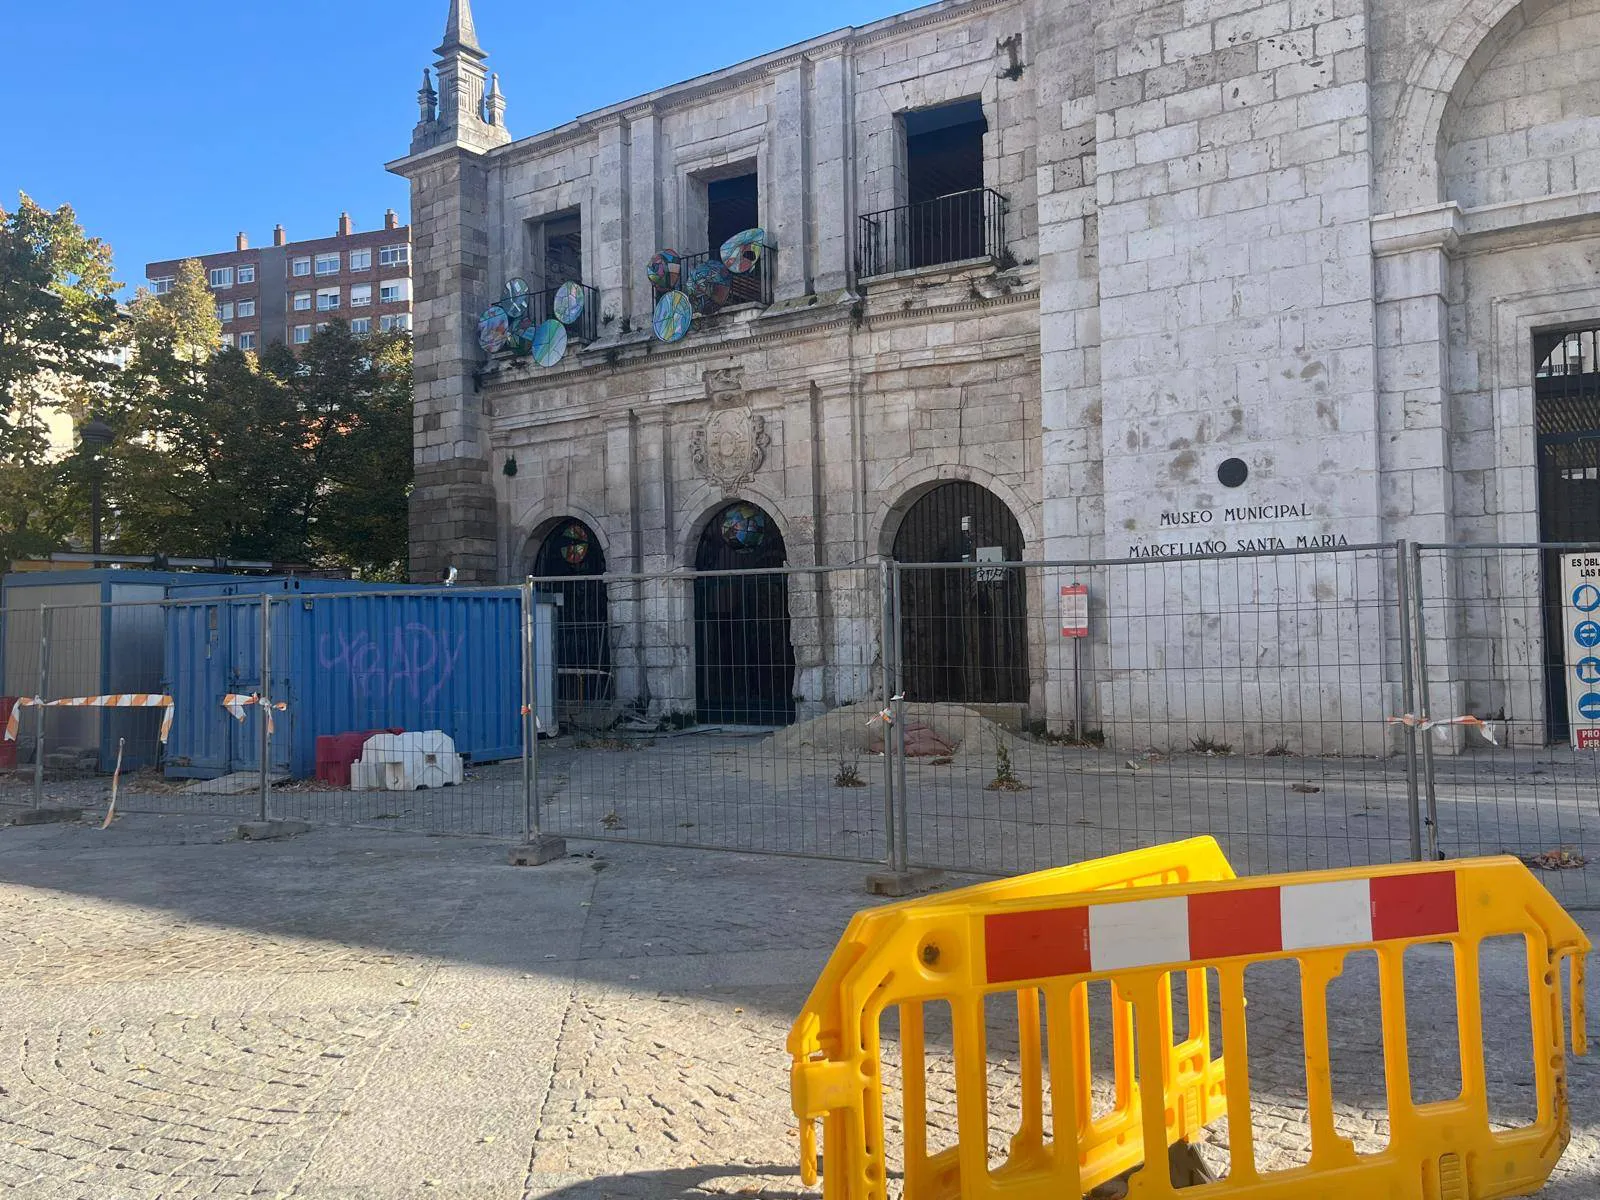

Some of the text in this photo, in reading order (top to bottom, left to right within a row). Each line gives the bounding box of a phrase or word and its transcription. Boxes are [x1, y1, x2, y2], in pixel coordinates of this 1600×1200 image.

[1160, 503, 1312, 526] MUSEO MUNICIPAL
[1129, 534, 1348, 558] MARCELIANO SANTA MARIA
[1571, 558, 1582, 567] ES
[1580, 569, 1596, 577] LAS
